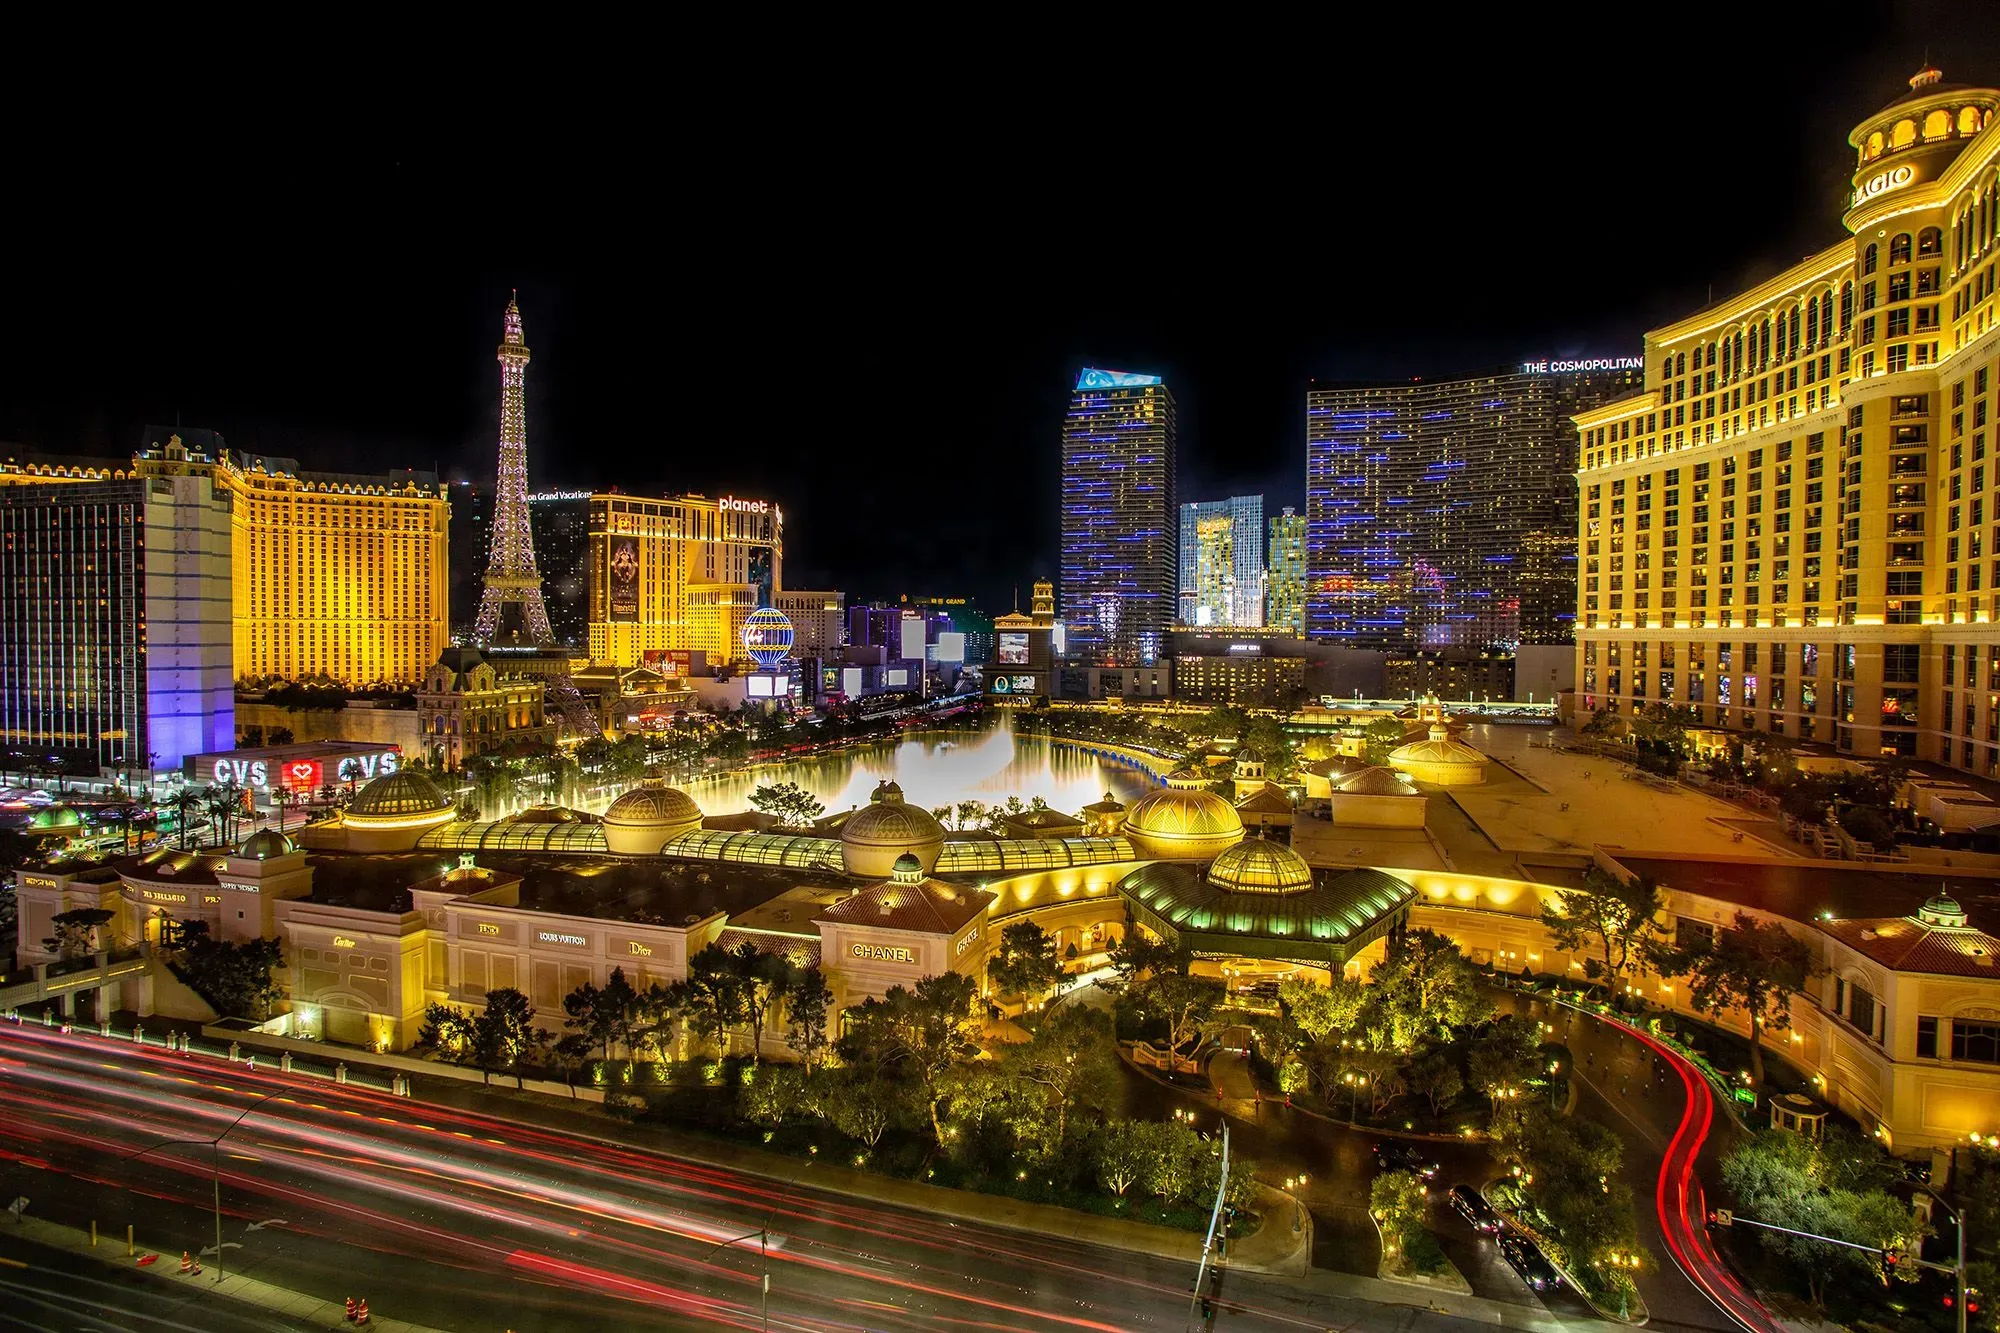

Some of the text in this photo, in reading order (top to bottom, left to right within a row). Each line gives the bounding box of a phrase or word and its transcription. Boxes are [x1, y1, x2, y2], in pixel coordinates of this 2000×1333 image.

[1524, 357, 1643, 373] THE COSMOPOLITAN
[537, 492, 558, 501] Grand
[559, 490, 592, 500] Vacations
[719, 495, 768, 514] planet
[214, 758, 268, 787] CVS
[338, 752, 398, 782] CVS
[539, 931, 586, 946] LOUIS VUITTON
[628, 942, 652, 957] Dior
[852, 944, 915, 963] CHANEL
